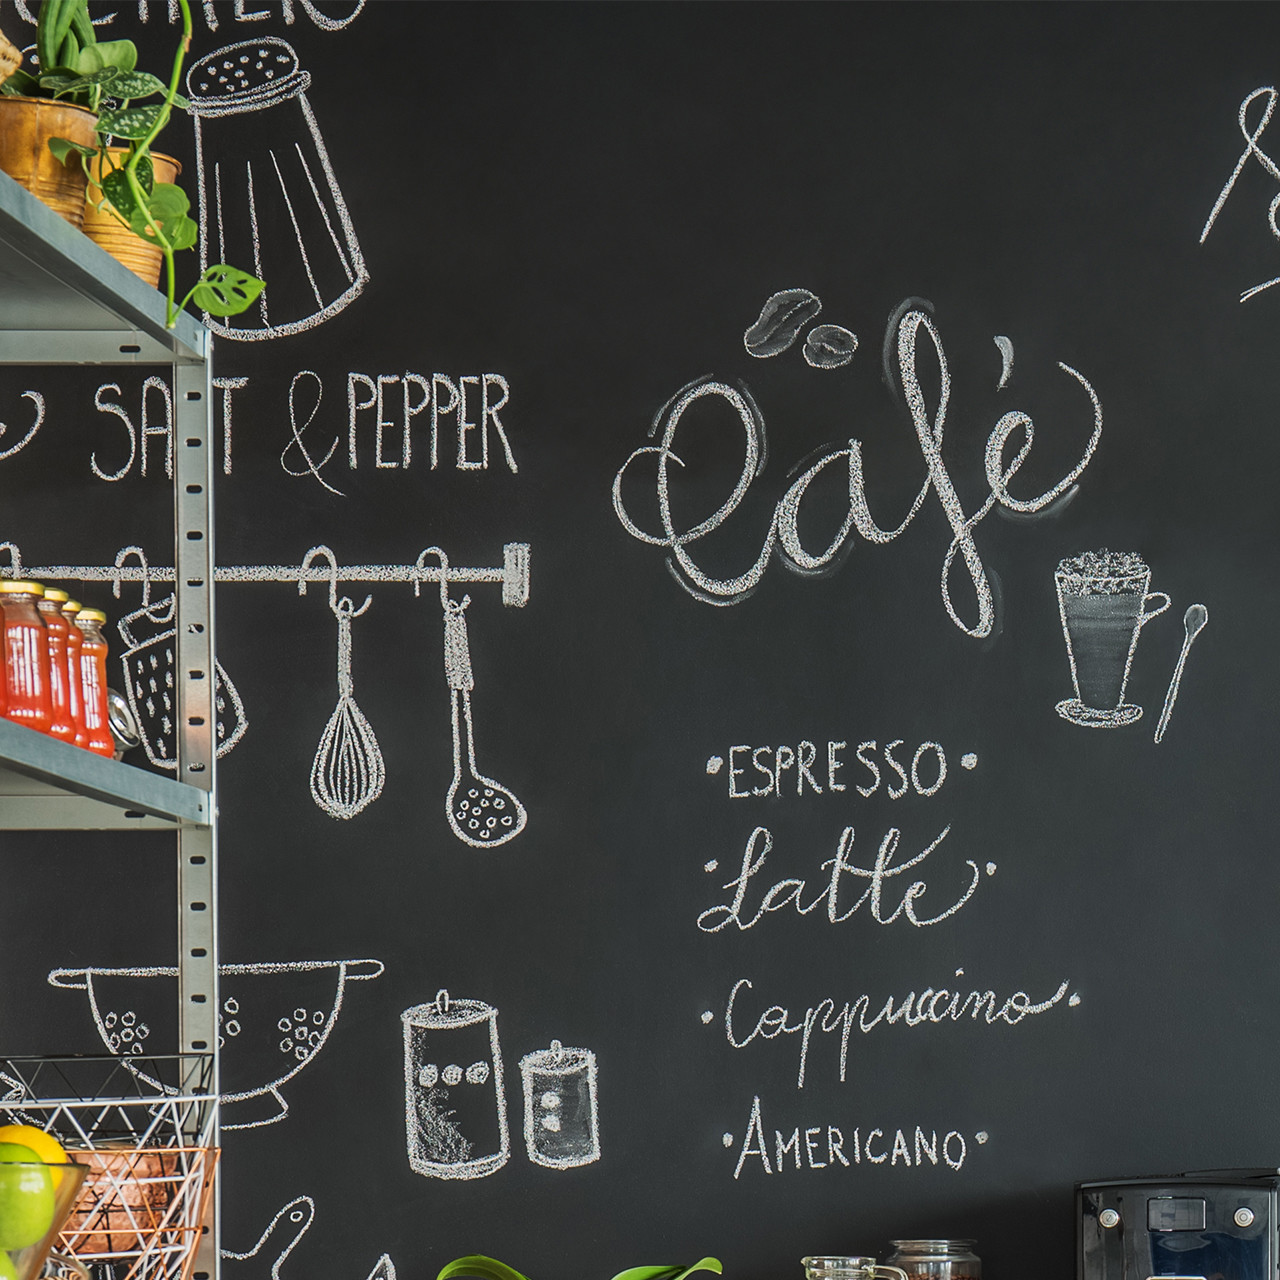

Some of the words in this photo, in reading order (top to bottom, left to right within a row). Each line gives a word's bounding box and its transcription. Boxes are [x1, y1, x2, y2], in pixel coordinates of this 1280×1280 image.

[91, 375, 249, 482] SAT
[280, 370, 347, 497] &
[347, 371, 518, 474] PEPPER
[729, 740, 948, 800] ESPRESSO
[697, 824, 980, 932] Latte
[725, 968, 1069, 1088] Cappuccino
